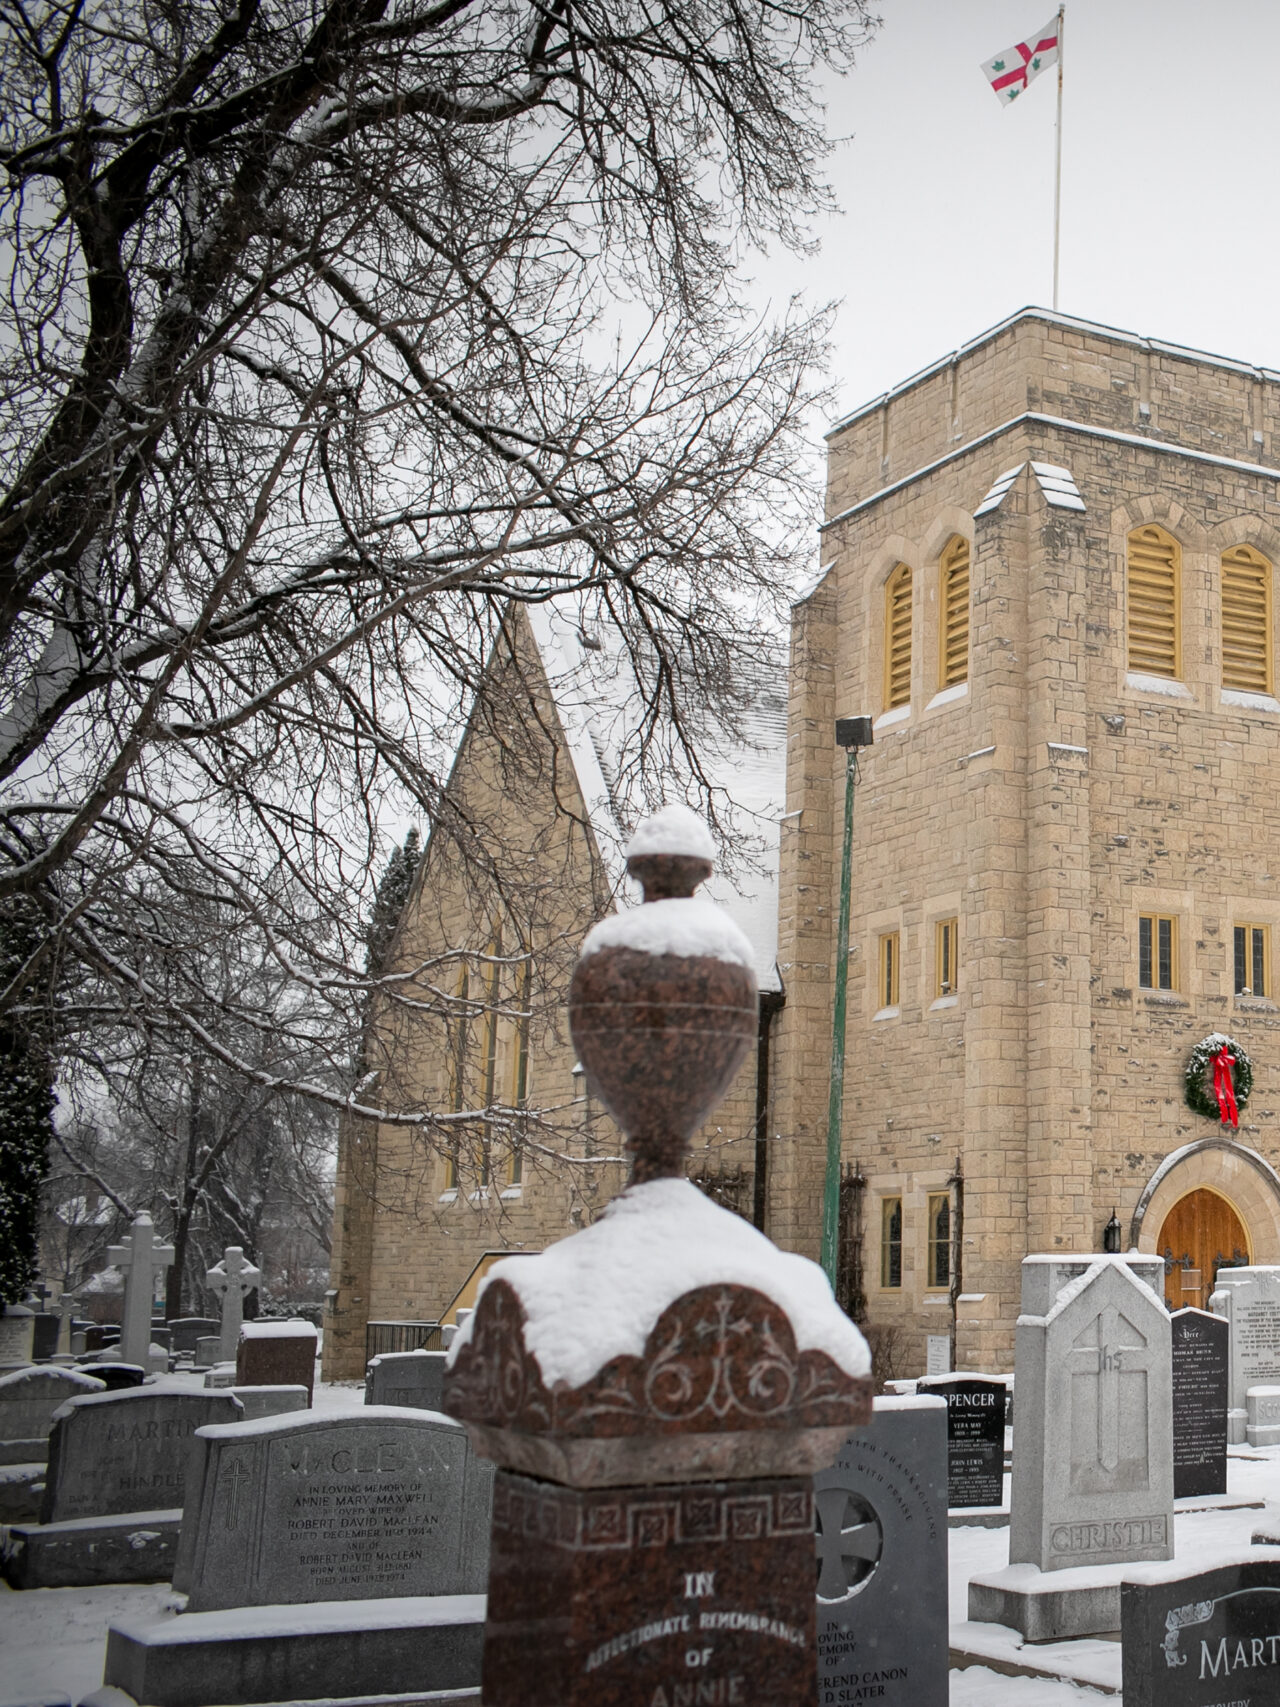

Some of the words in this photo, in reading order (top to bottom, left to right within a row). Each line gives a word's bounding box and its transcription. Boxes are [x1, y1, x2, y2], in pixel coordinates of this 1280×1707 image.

[944, 1393, 995, 1407] PENCER
[107, 1419, 202, 1441] MARTIN
[309, 1485, 320, 1494] IN
[322, 1485, 361, 1493] LOVING
[365, 1483, 406, 1492] MEMORY
[410, 1482, 423, 1491] OF
[846, 1439, 876, 1453] WITH
[882, 1451, 937, 1539] THANKSGIVING
[857, 1464, 884, 1482] WITH
[887, 1483, 913, 1521] PRAISE
[292, 1497, 330, 1507] ANNIE
[336, 1496, 369, 1506] MARY
[369, 1507, 391, 1515] WIFE
[395, 1506, 405, 1514] OF
[287, 1519, 335, 1529] ROBERT
[341, 1518, 377, 1528] DAVID
[290, 1532, 317, 1541] DIED
[323, 1530, 380, 1539] DECEMBER
[1051, 1520, 1165, 1551] CHRISTIE
[300, 1555, 338, 1565] ROBERT
[341, 1552, 372, 1562] DAVID
[310, 1567, 334, 1575] BORN
[315, 1576, 336, 1585] DIED
[684, 1571, 717, 1599] IN
[826, 1622, 838, 1632] IN
[584, 1614, 690, 1673] AFFECTIONATE
[699, 1611, 806, 1649] REMEMBRANCE
[818, 1631, 854, 1644] OVING
[819, 1643, 857, 1656] EMORY
[685, 1647, 714, 1668] OF
[825, 1656, 840, 1666] OF
[817, 1674, 859, 1690] EREND
[862, 1667, 908, 1684] CANON
[650, 1676, 746, 1707] ANNIE
[838, 1685, 885, 1702] SLATER
